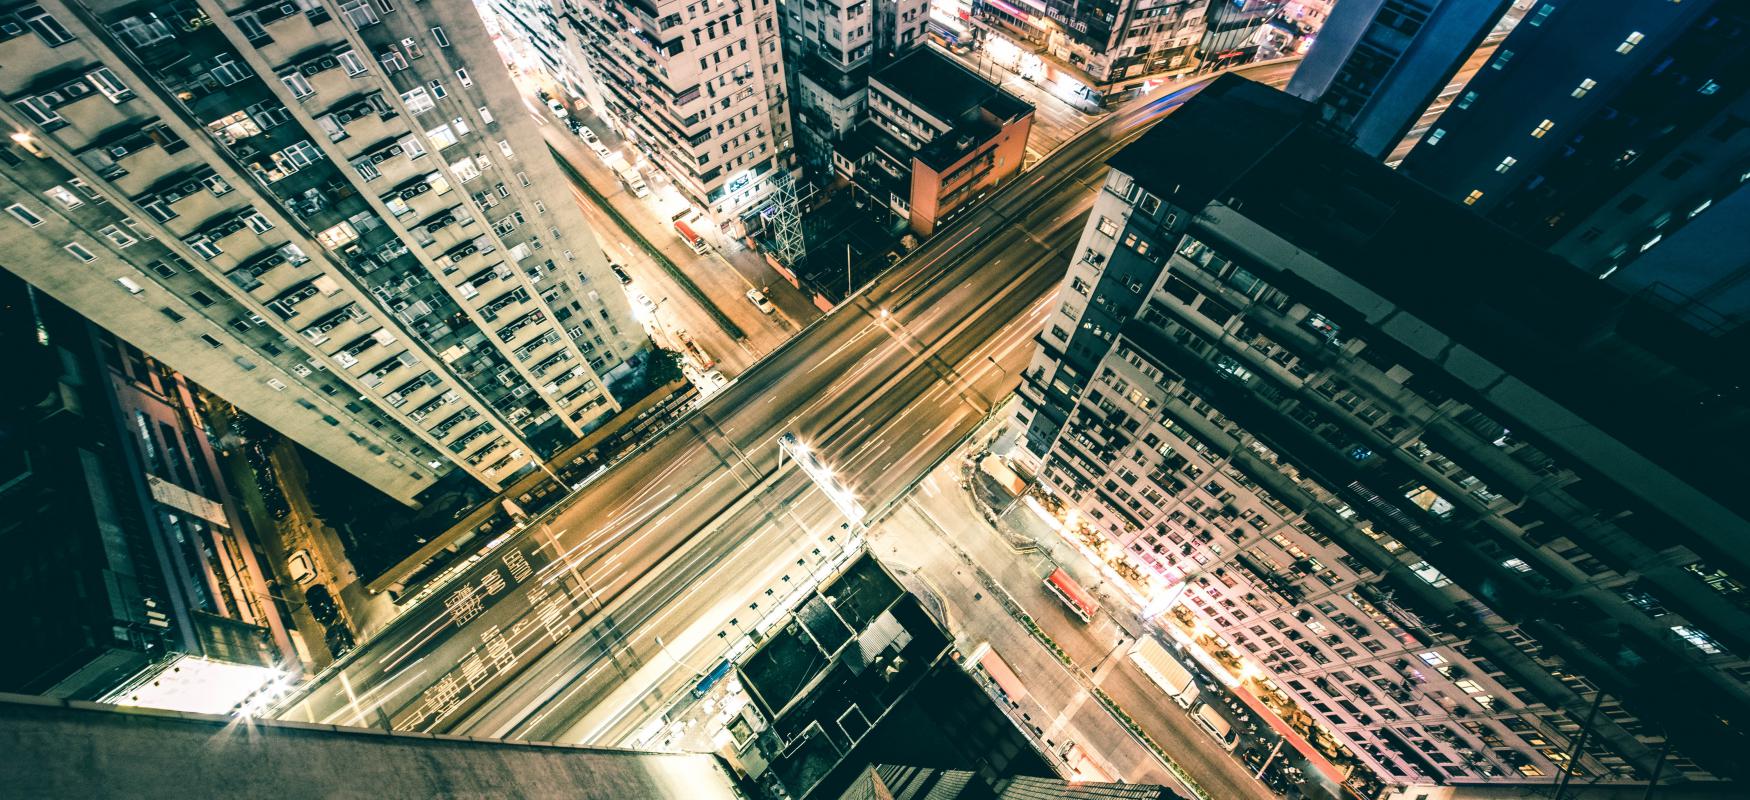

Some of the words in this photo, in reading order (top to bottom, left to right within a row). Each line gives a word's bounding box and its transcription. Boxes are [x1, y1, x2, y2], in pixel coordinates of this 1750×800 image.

[481, 568, 506, 596] ROAD
[502, 547, 534, 583] LEIGHTON
[457, 646, 488, 691] TUNNEL
[480, 624, 518, 675] ABERDEEN
